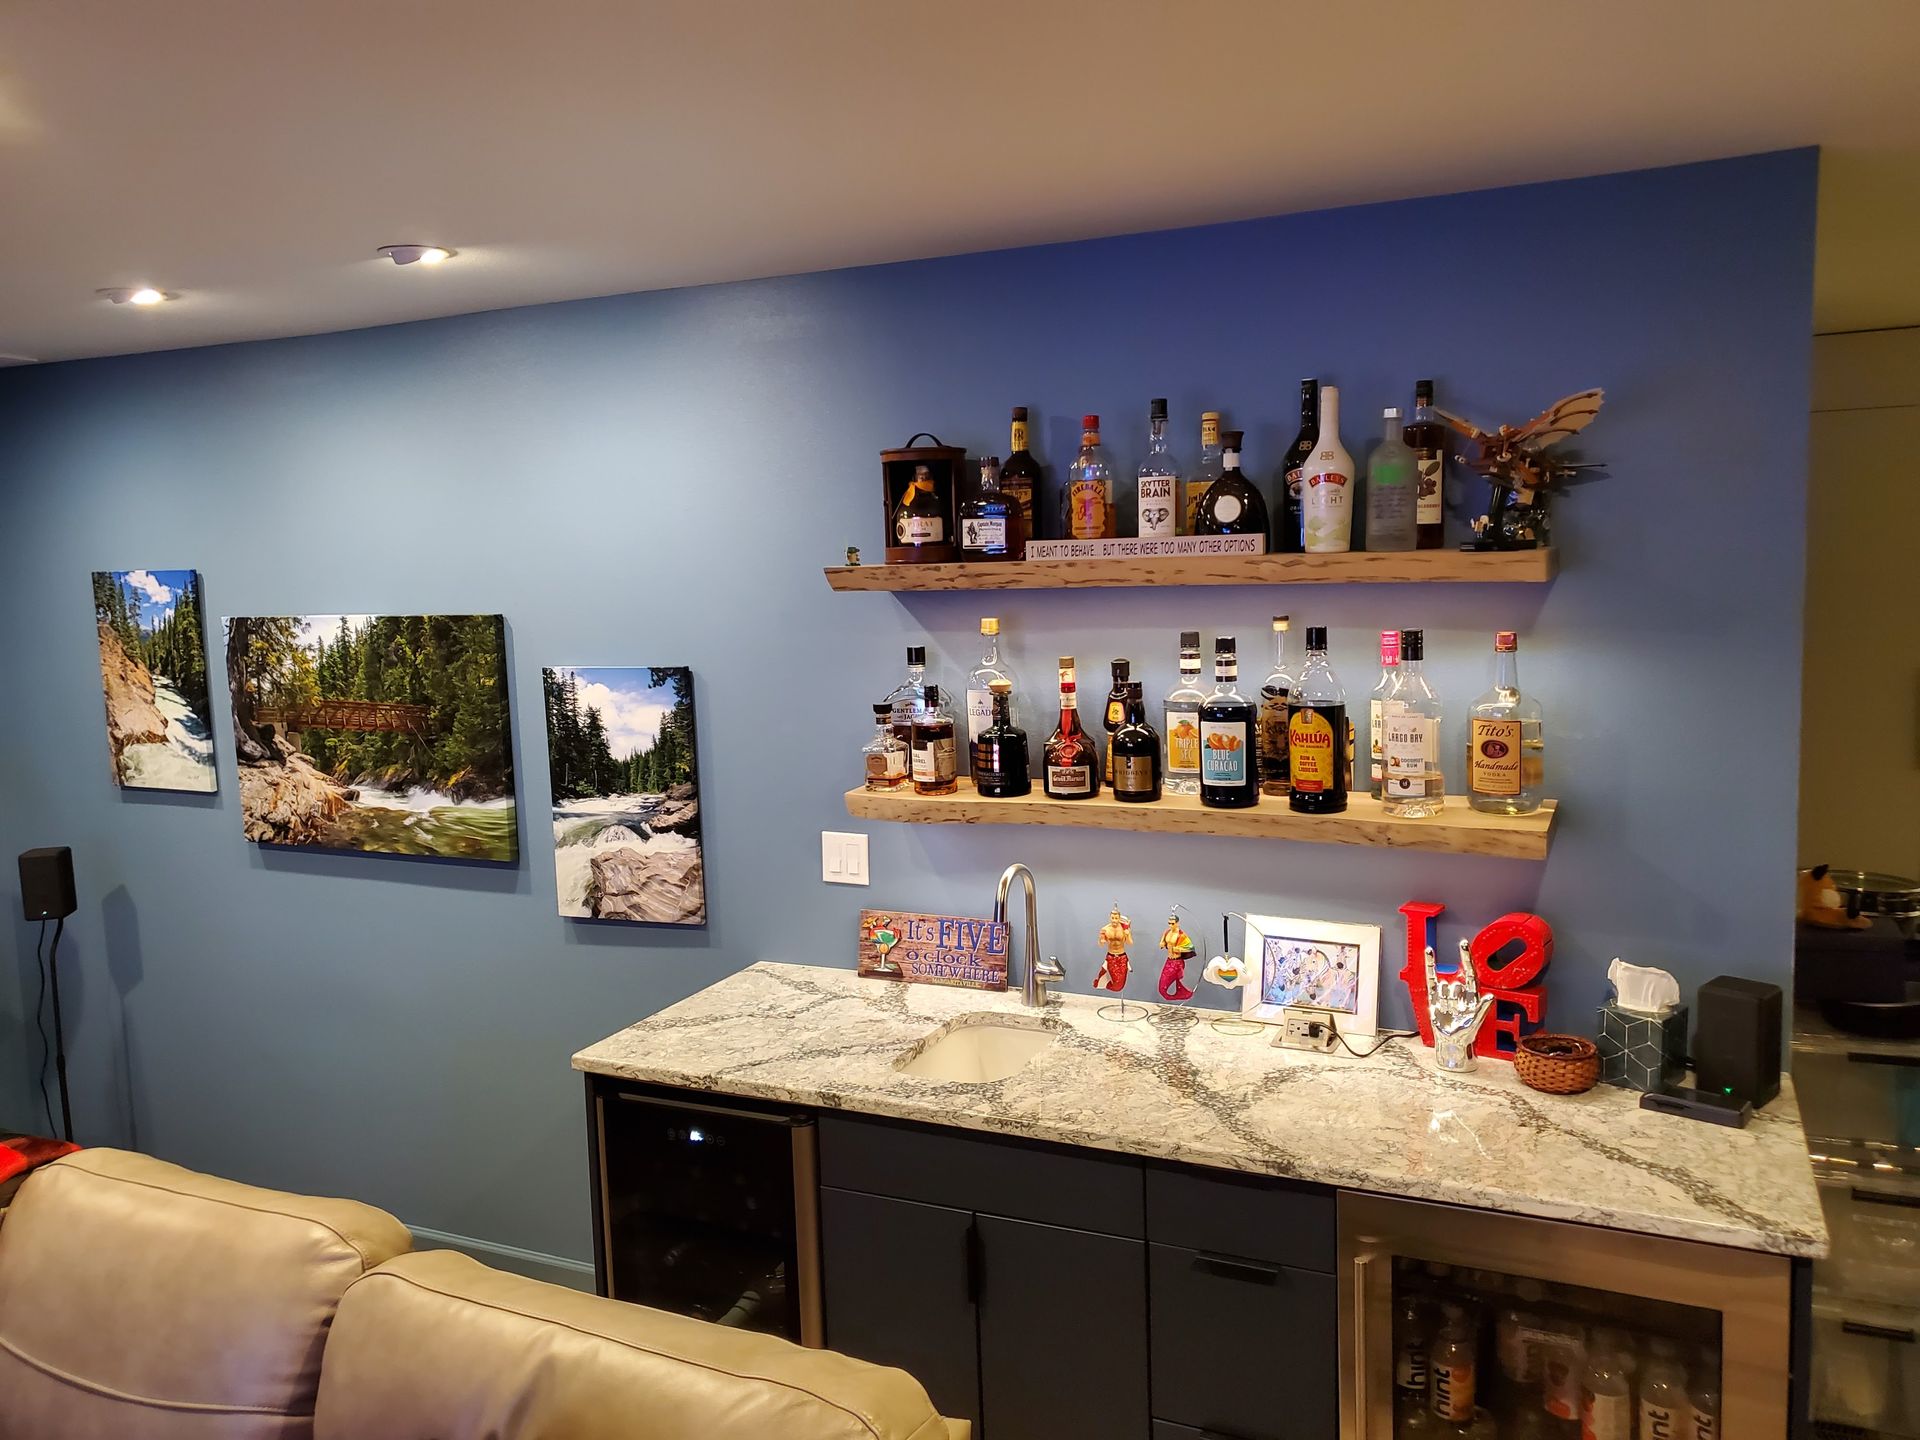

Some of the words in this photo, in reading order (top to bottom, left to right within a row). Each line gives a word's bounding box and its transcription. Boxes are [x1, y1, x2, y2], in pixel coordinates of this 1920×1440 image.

[1072, 483, 1102, 497] FIREBALL
[1141, 487, 1171, 499] BRAIN
[1312, 496, 1343, 505] LHT
[1030, 546, 1034, 558] I
[1036, 545, 1058, 557] MEANT
[1060, 545, 1069, 557] TO
[1103, 544, 1115, 556] BUT
[1118, 543, 1138, 555] THERE
[1140, 542, 1158, 554] WERE
[1161, 542, 1174, 554] TOO
[1177, 541, 1197, 554] MANY
[1199, 540, 1221, 553] OTHER
[1224, 539, 1255, 552] OPTIONS
[969, 708, 993, 716] LEGAD
[1388, 732, 1407, 742] LARGO
[1410, 733, 1423, 743] BAY
[1478, 724, 1514, 738] Tito's
[1176, 738, 1198, 748] TRIPLE
[1290, 730, 1330, 748] KAHLÚA
[1181, 749, 1192, 760] SEC
[1212, 749, 1230, 760] BLUE
[1474, 760, 1519, 771] Handmade
[908, 919, 935, 942] It's
[936, 918, 1005, 954] FIVE
[906, 948, 983, 967] o'clock
[911, 962, 1001, 984] SOMEWHERE
[1433, 1366, 1451, 1418] hint
[1648, 1409, 1670, 1440] nt
[1694, 1414, 1713, 1440] nt
